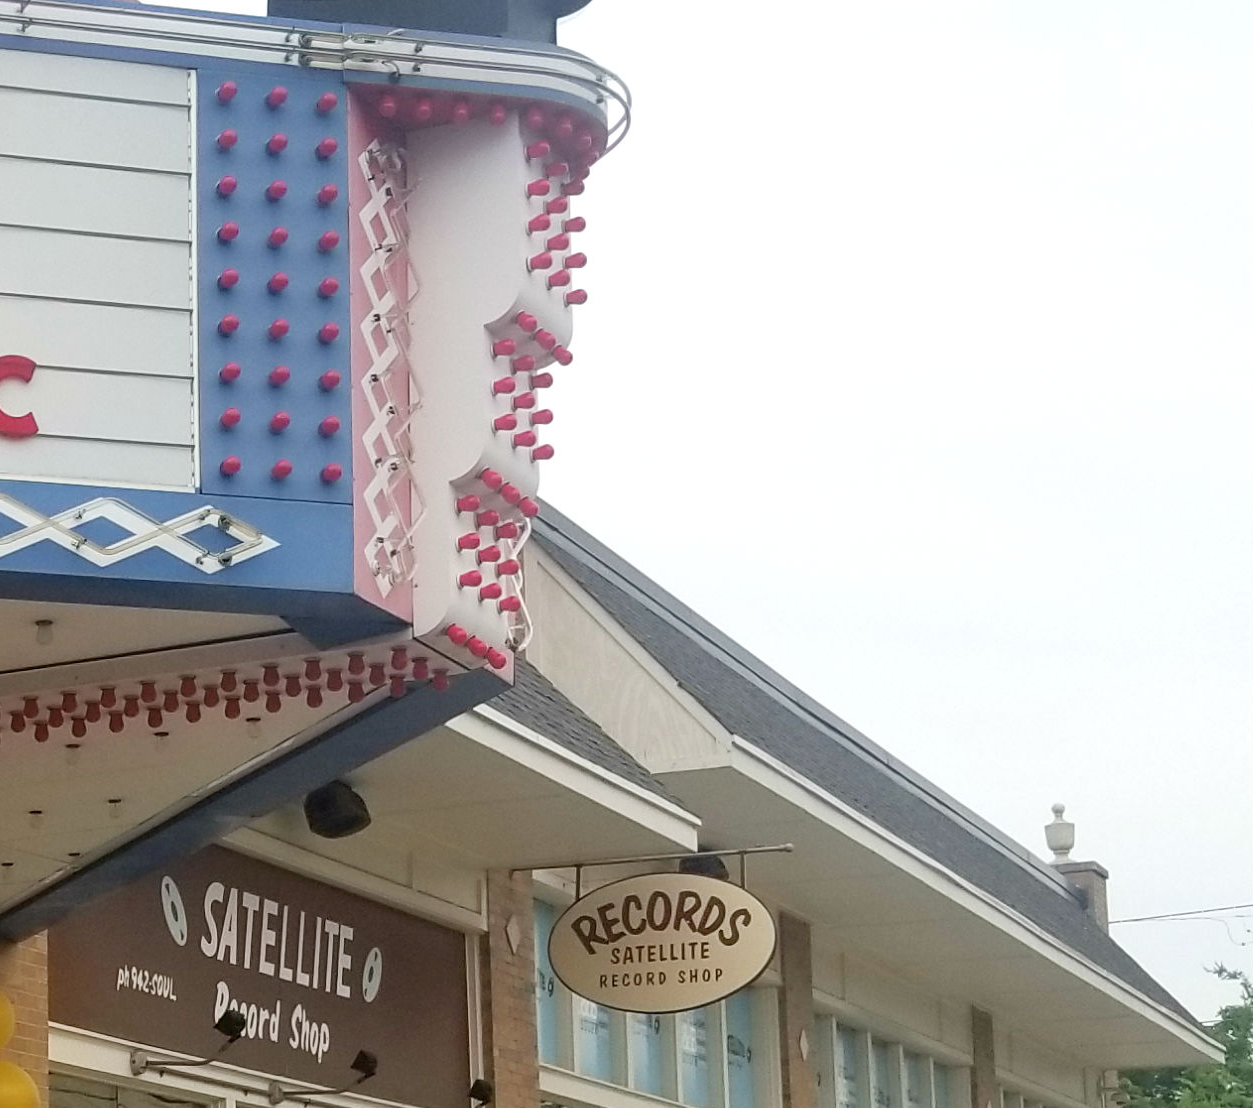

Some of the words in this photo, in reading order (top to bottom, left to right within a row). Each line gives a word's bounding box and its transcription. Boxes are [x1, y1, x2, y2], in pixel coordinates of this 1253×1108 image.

[200, 880, 355, 999] SATELLITE
[571, 890, 752, 955] RECORDS
[610, 942, 711, 965] SATELLITE
[599, 970, 667, 989] RECORD
[678, 968, 724, 984] SHOP
[288, 1003, 331, 1065] Shop
